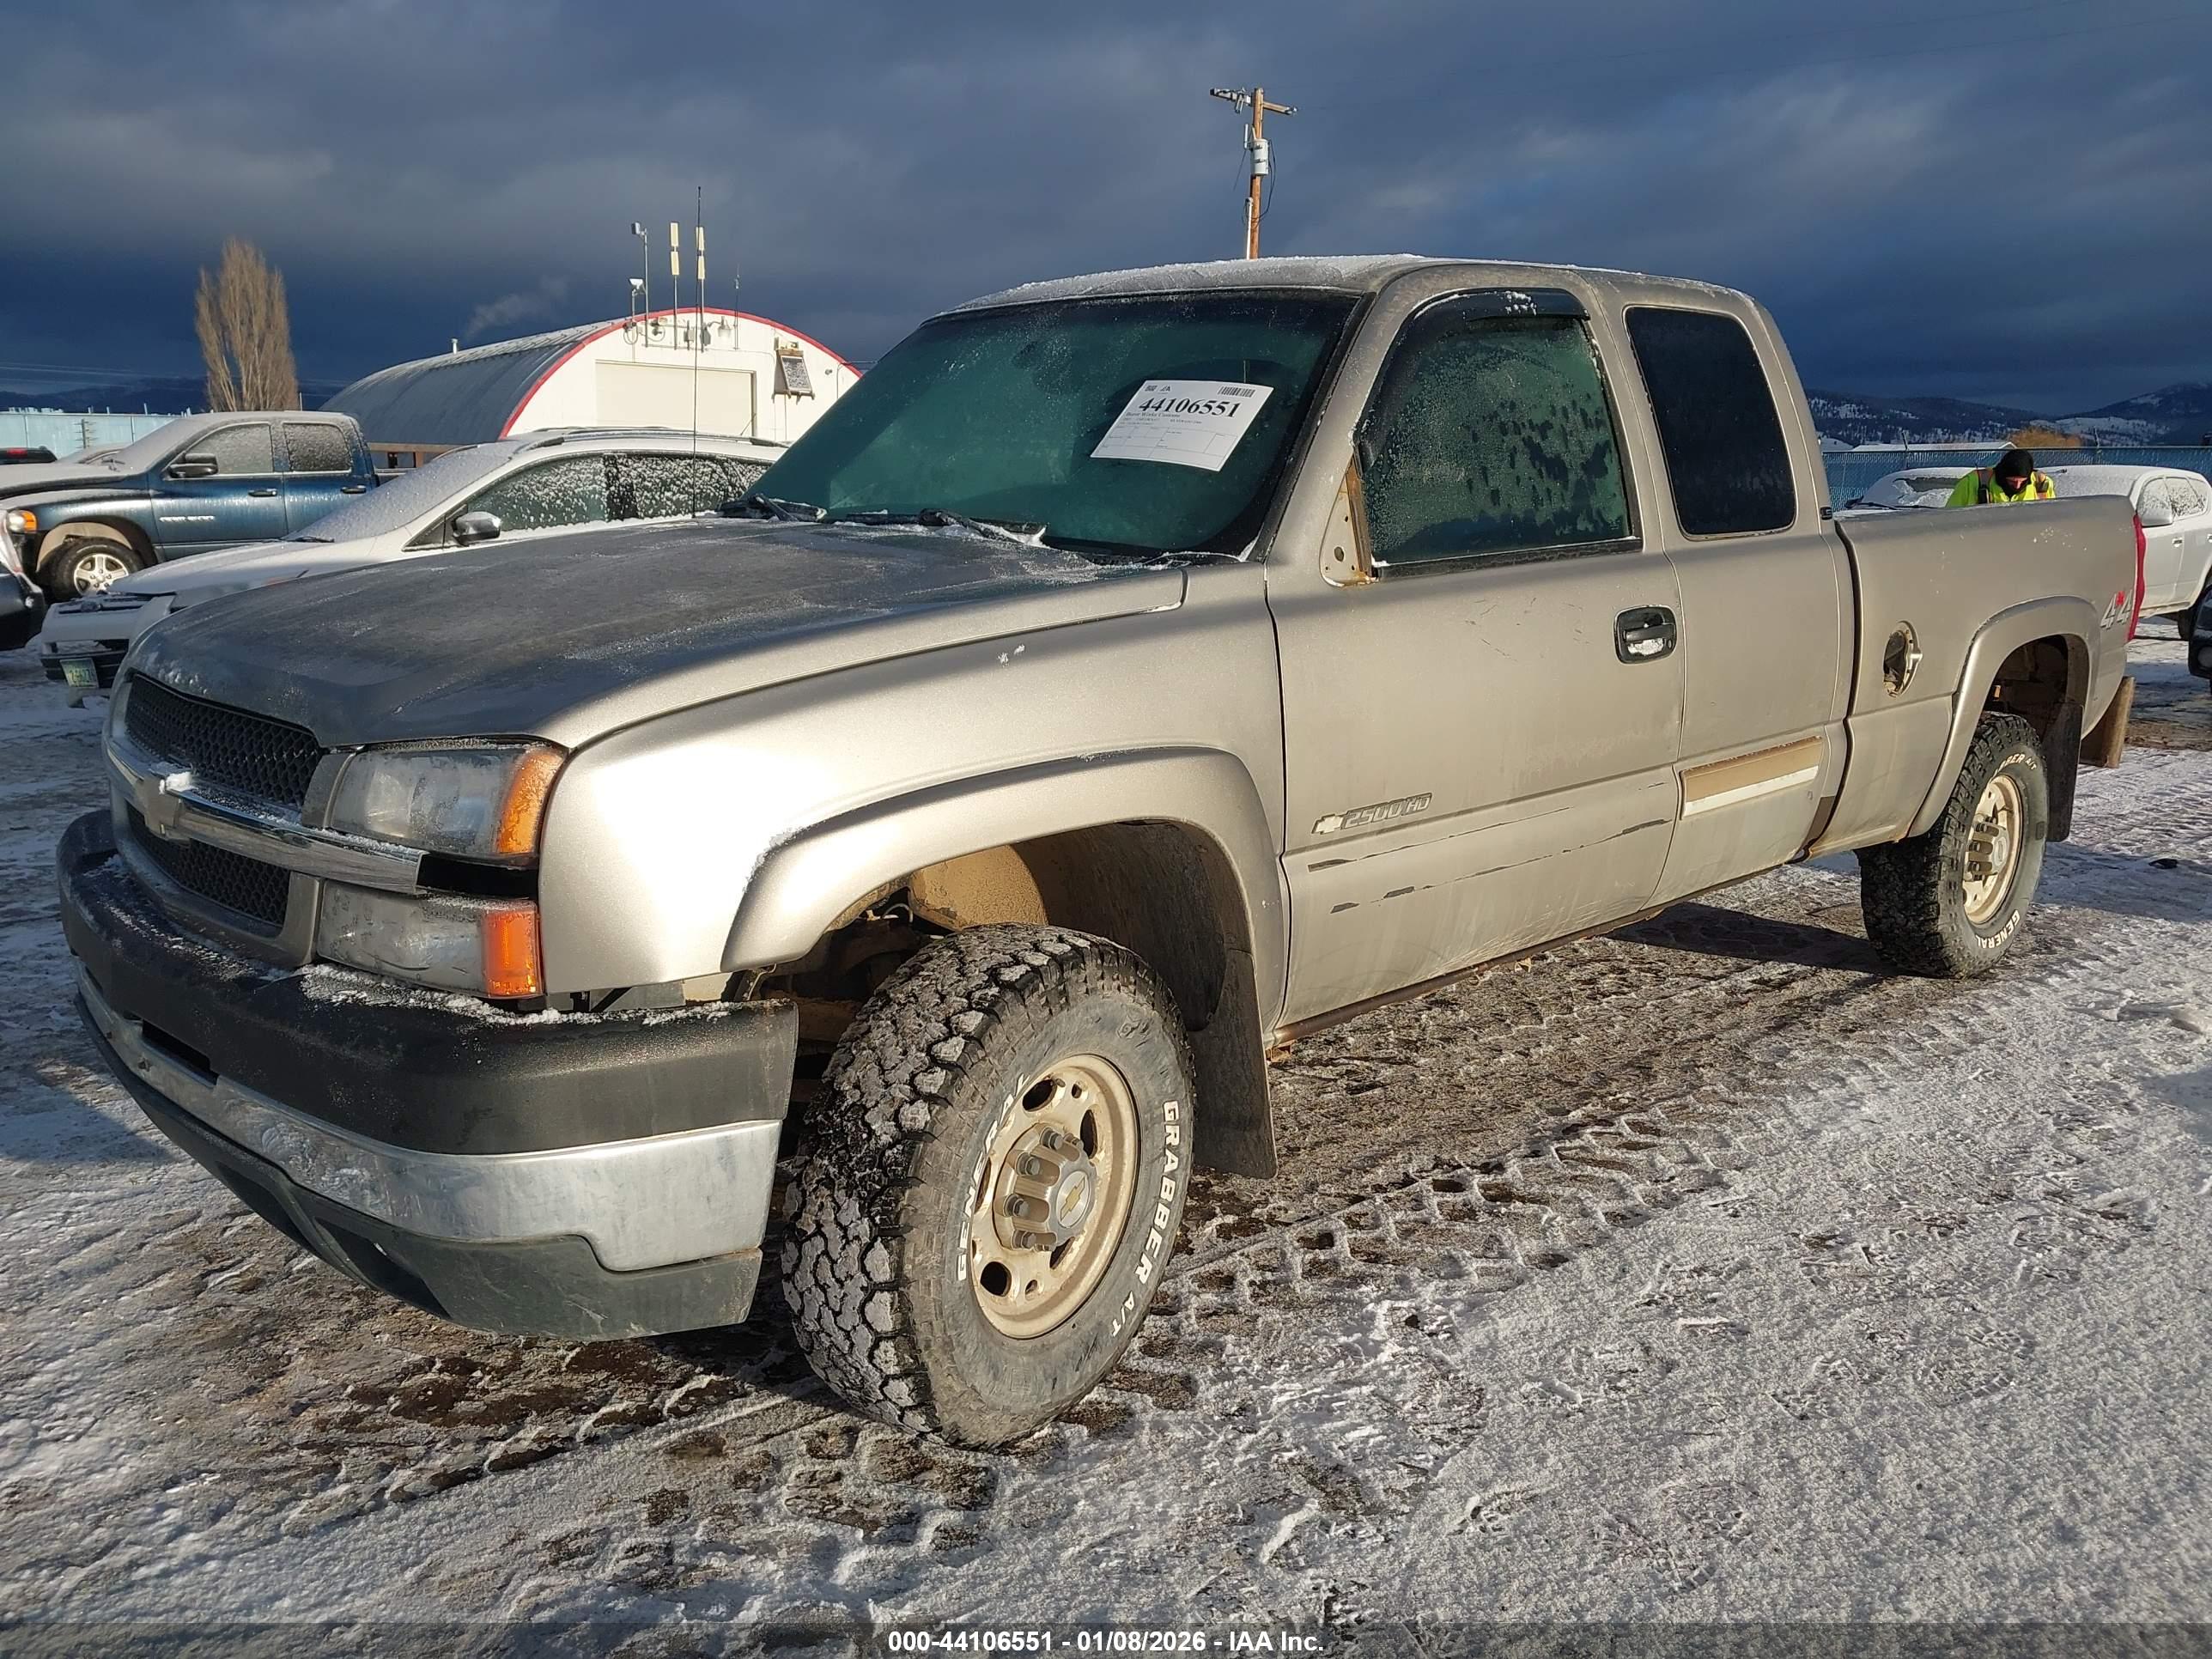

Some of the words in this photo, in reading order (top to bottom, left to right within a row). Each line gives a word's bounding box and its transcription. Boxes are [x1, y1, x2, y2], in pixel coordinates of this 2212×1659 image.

[1139, 398, 1242, 417] 44106551
[1344, 802, 1402, 829] 2500
[1406, 795, 1431, 813] HD
[1975, 909, 2021, 949] GENERAL
[957, 1073, 1030, 1281] GENERAL
[1135, 1101, 1180, 1285] GRABBER
[1112, 1291, 1135, 1337] A/T
